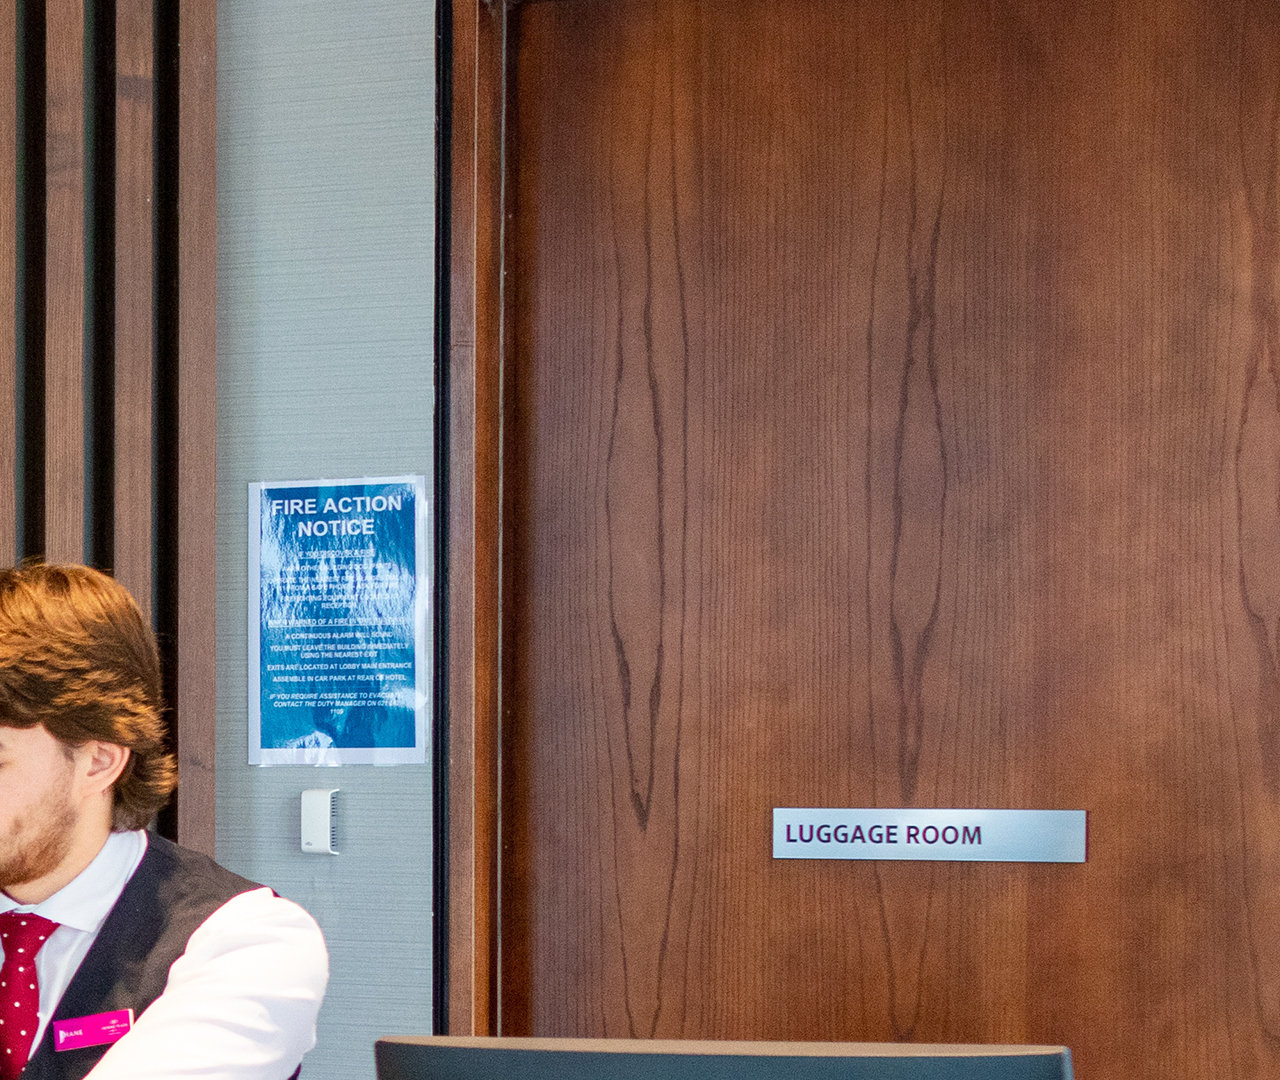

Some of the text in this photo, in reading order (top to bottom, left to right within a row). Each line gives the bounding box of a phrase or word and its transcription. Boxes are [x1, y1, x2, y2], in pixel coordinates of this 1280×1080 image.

[272, 496, 402, 515] FIRE ACTION
[298, 519, 375, 537] NOTICE
[785, 824, 982, 845] LUGGAGE ROOM
